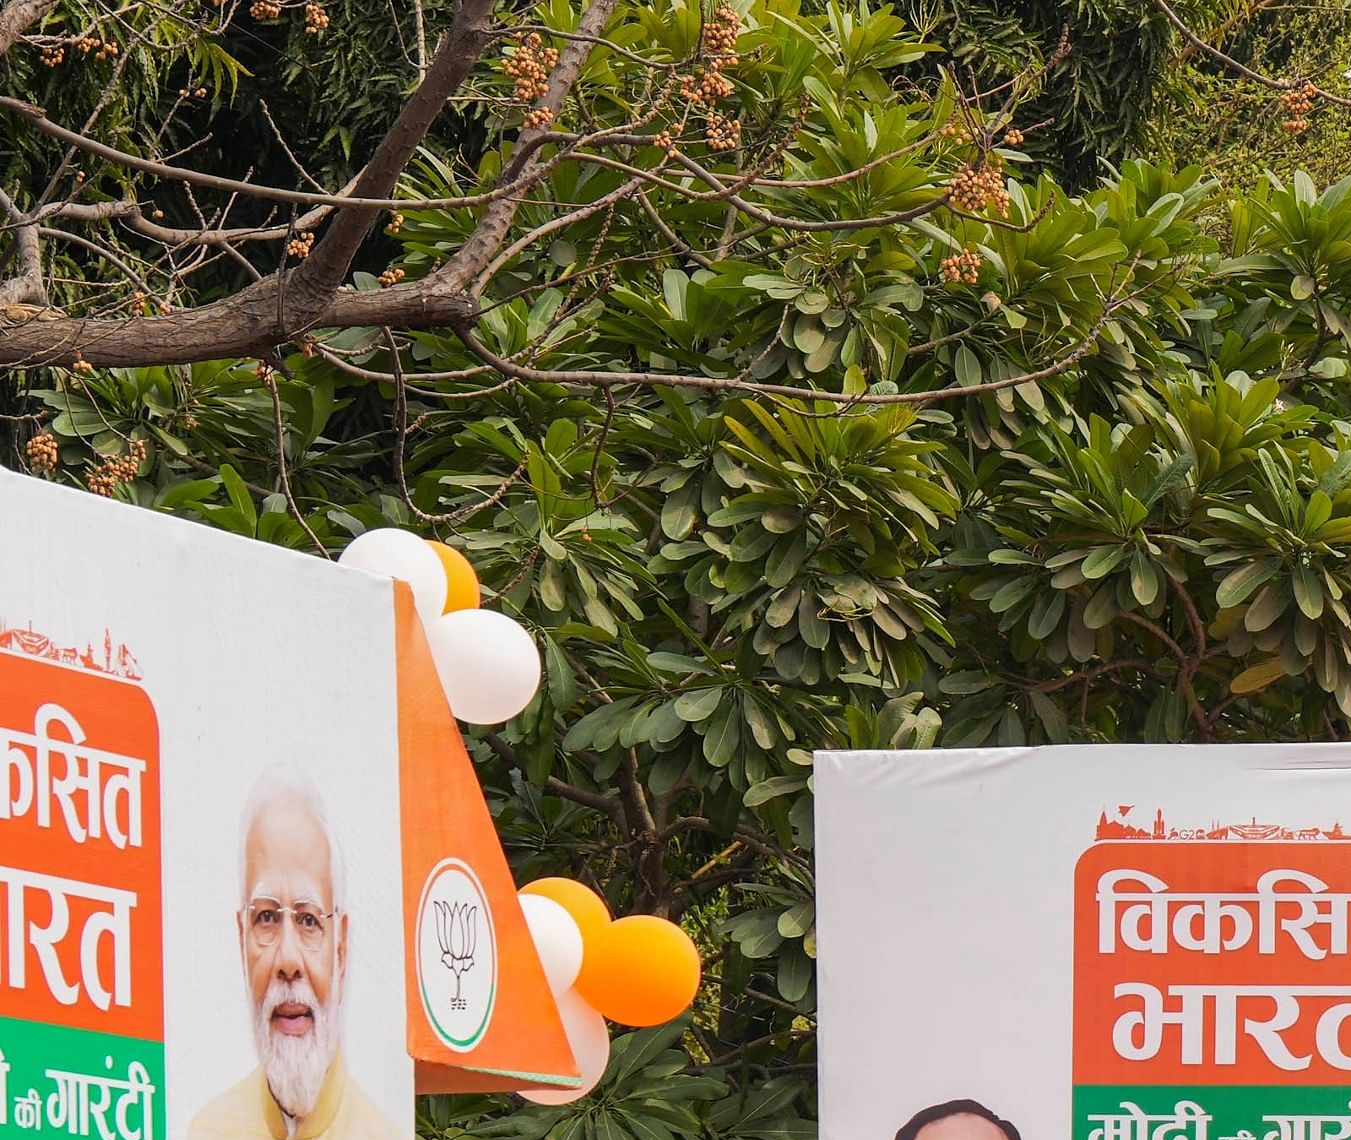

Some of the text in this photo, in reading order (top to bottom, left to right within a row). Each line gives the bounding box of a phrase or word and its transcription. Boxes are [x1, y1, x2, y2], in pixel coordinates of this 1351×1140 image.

[0, 703, 147, 850] कसित
[0, 865, 137, 1012] ारत
[14, 1088, 42, 1131] की
